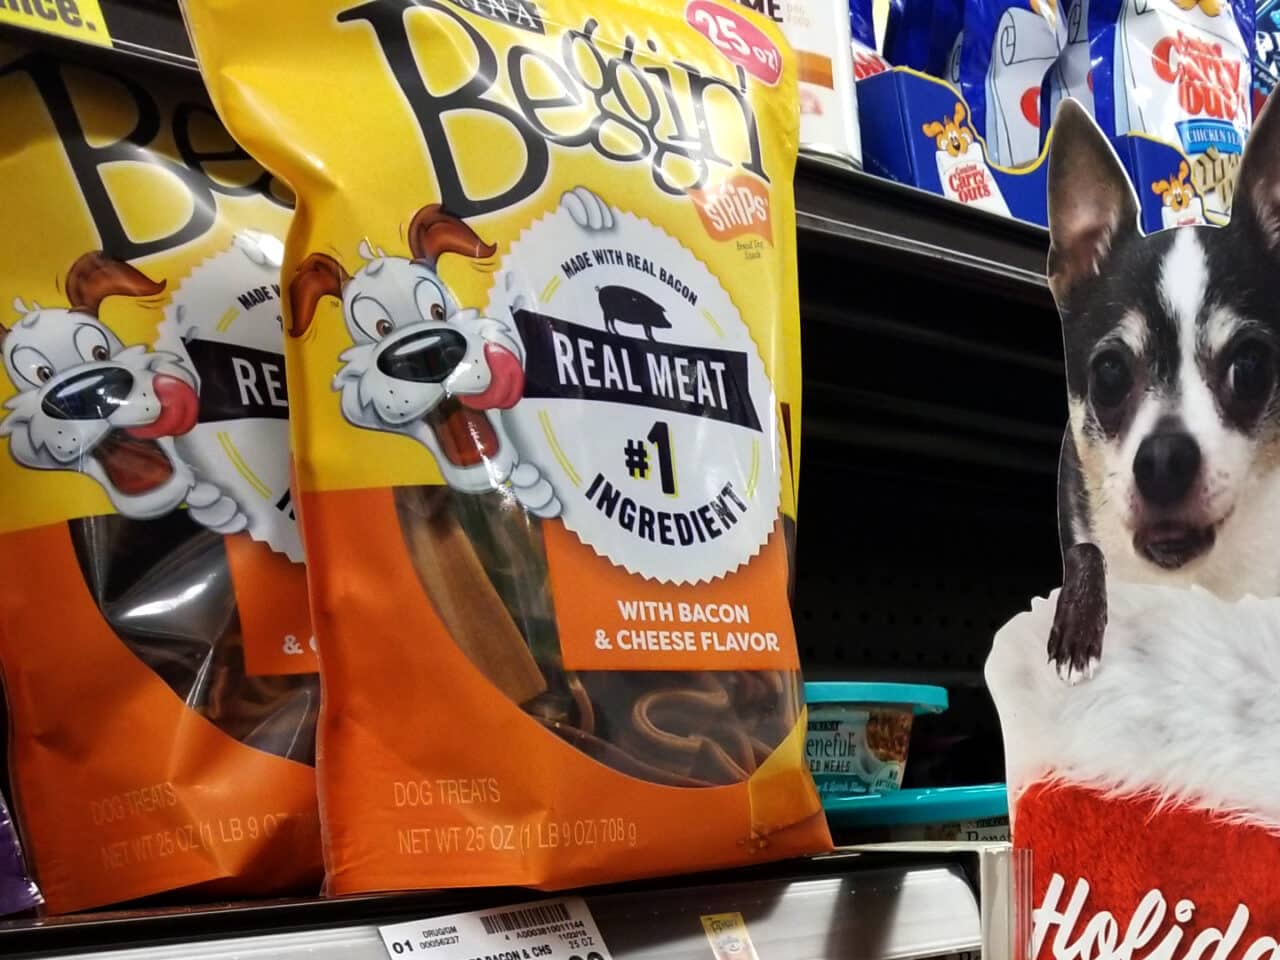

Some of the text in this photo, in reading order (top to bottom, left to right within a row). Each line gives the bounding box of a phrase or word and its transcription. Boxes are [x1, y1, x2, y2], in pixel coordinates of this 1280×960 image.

[694, 10, 751, 54] 25
[754, 43, 782, 71] oz!
[561, 249, 699, 306] MADE WITH REAL BACON
[237, 286, 272, 311] MADE
[553, 333, 729, 411] REAL MEAT
[624, 420, 677, 497] #1
[584, 472, 749, 547] INGREDIENT
[617, 600, 750, 624] WITH BACON
[594, 628, 780, 653] & CHEESE FLAVOR
[393, 778, 500, 808] DOG TREATS
[399, 828, 434, 855] NET
[436, 826, 463, 854] WT
[465, 825, 488, 852] 25
[490, 823, 516, 851] OZ
[536, 822, 561, 849] LB
[561, 821, 571, 848] 9
[599, 819, 626, 845] 708
[627, 823, 637, 847] g
[531, 944, 553, 958] CHS
